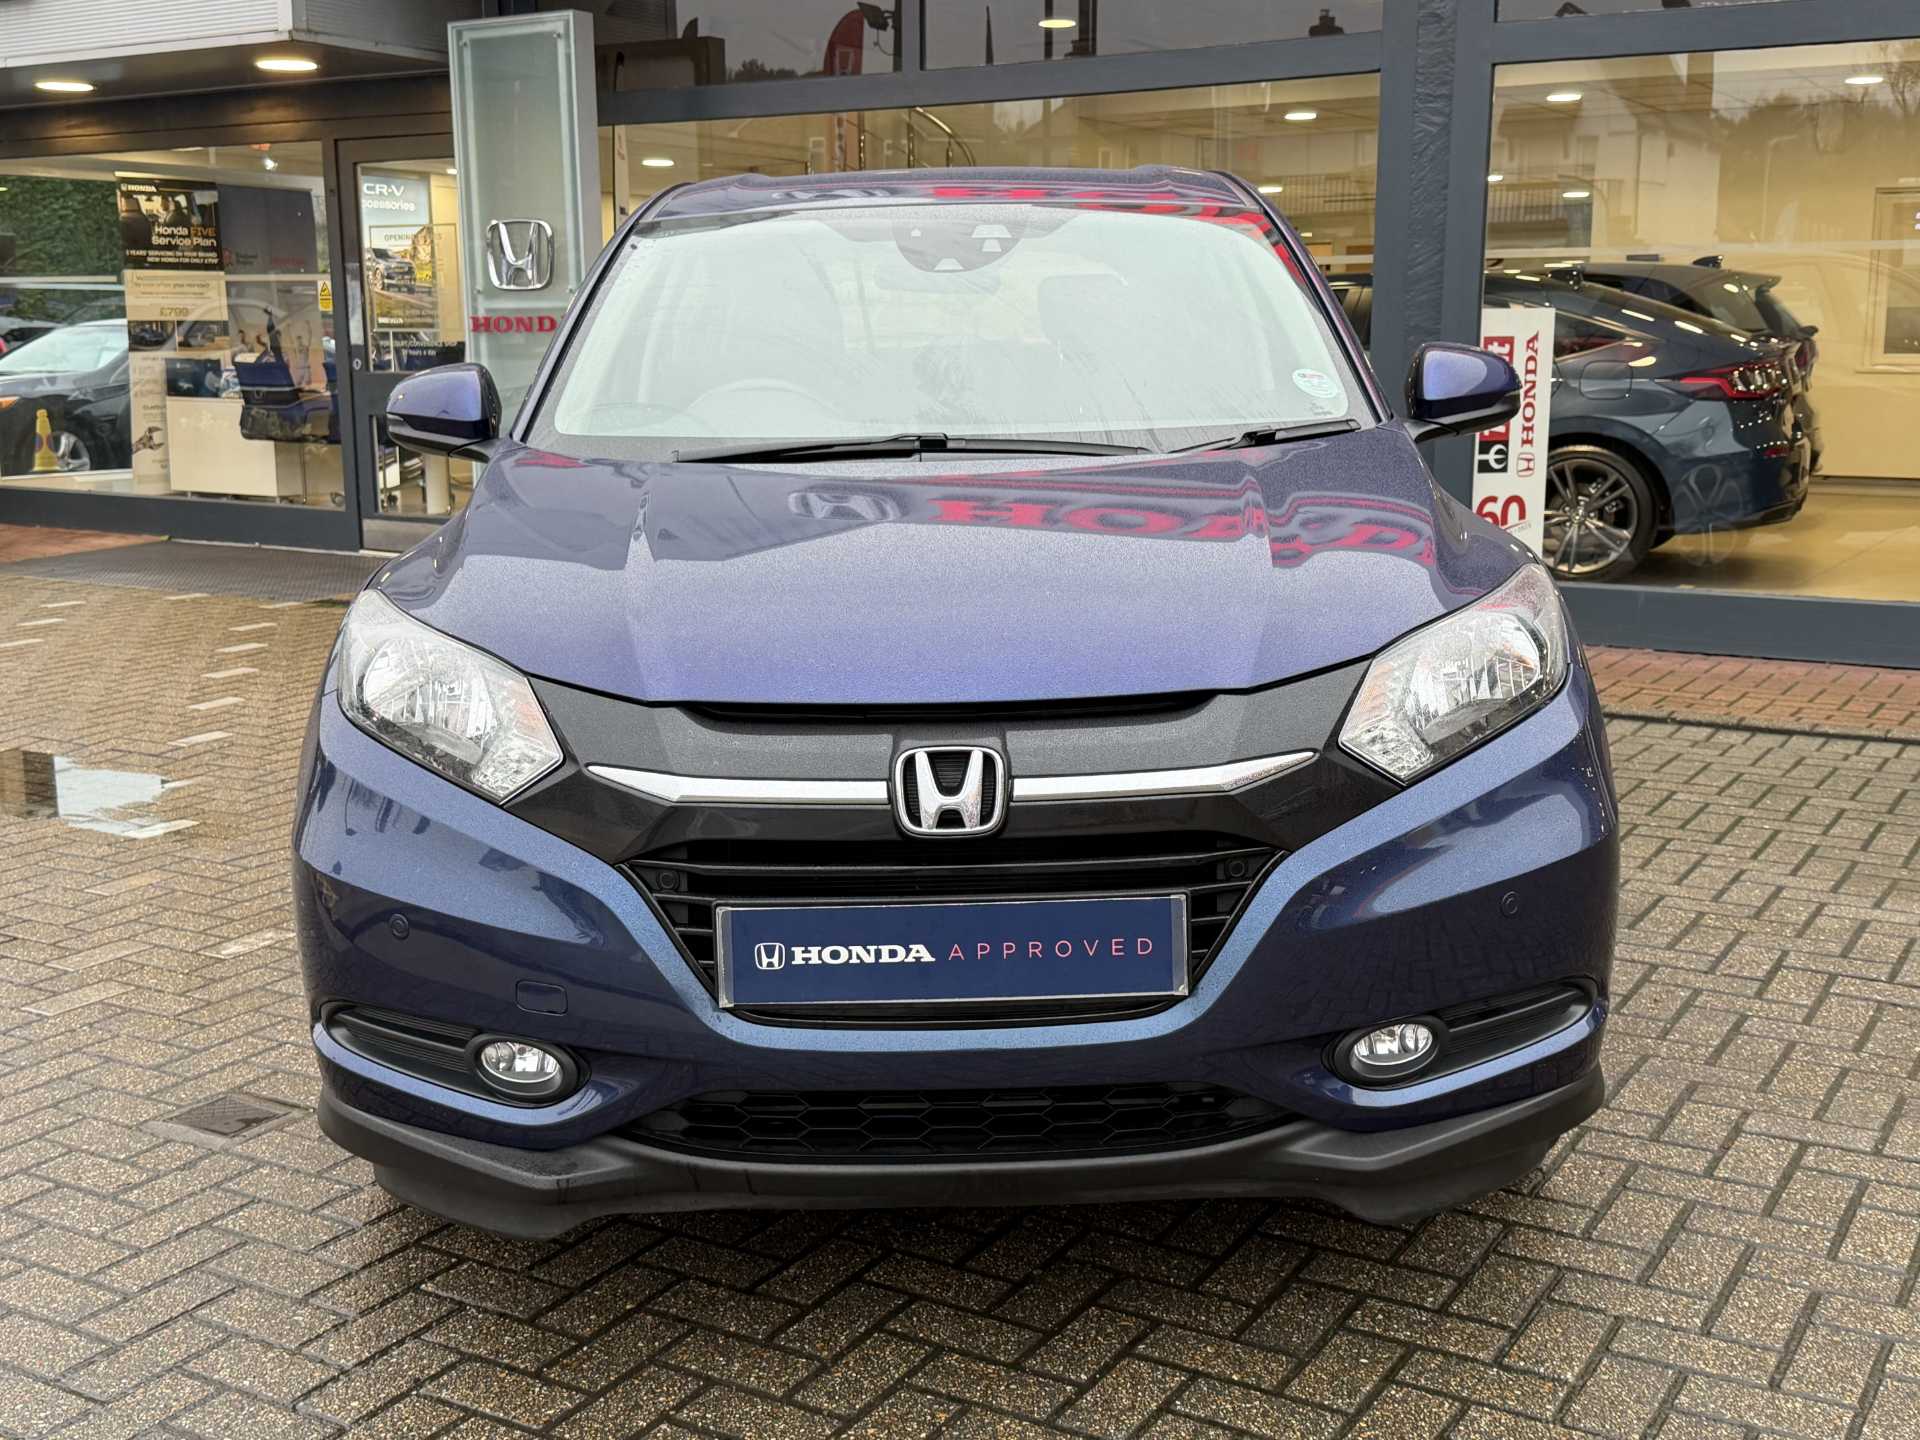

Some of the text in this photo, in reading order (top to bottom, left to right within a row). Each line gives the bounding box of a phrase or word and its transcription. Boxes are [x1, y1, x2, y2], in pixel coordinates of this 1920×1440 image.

[128, 184, 157, 192] HONDA
[363, 183, 404, 196] CR-V
[155, 223, 216, 237] Honda FIVE
[152, 234, 217, 247] Service Plan
[470, 314, 565, 333] HOND
[1521, 330, 1539, 448] HONDA
[791, 944, 936, 965] HONDA
[948, 937, 1153, 961] APPROVED
